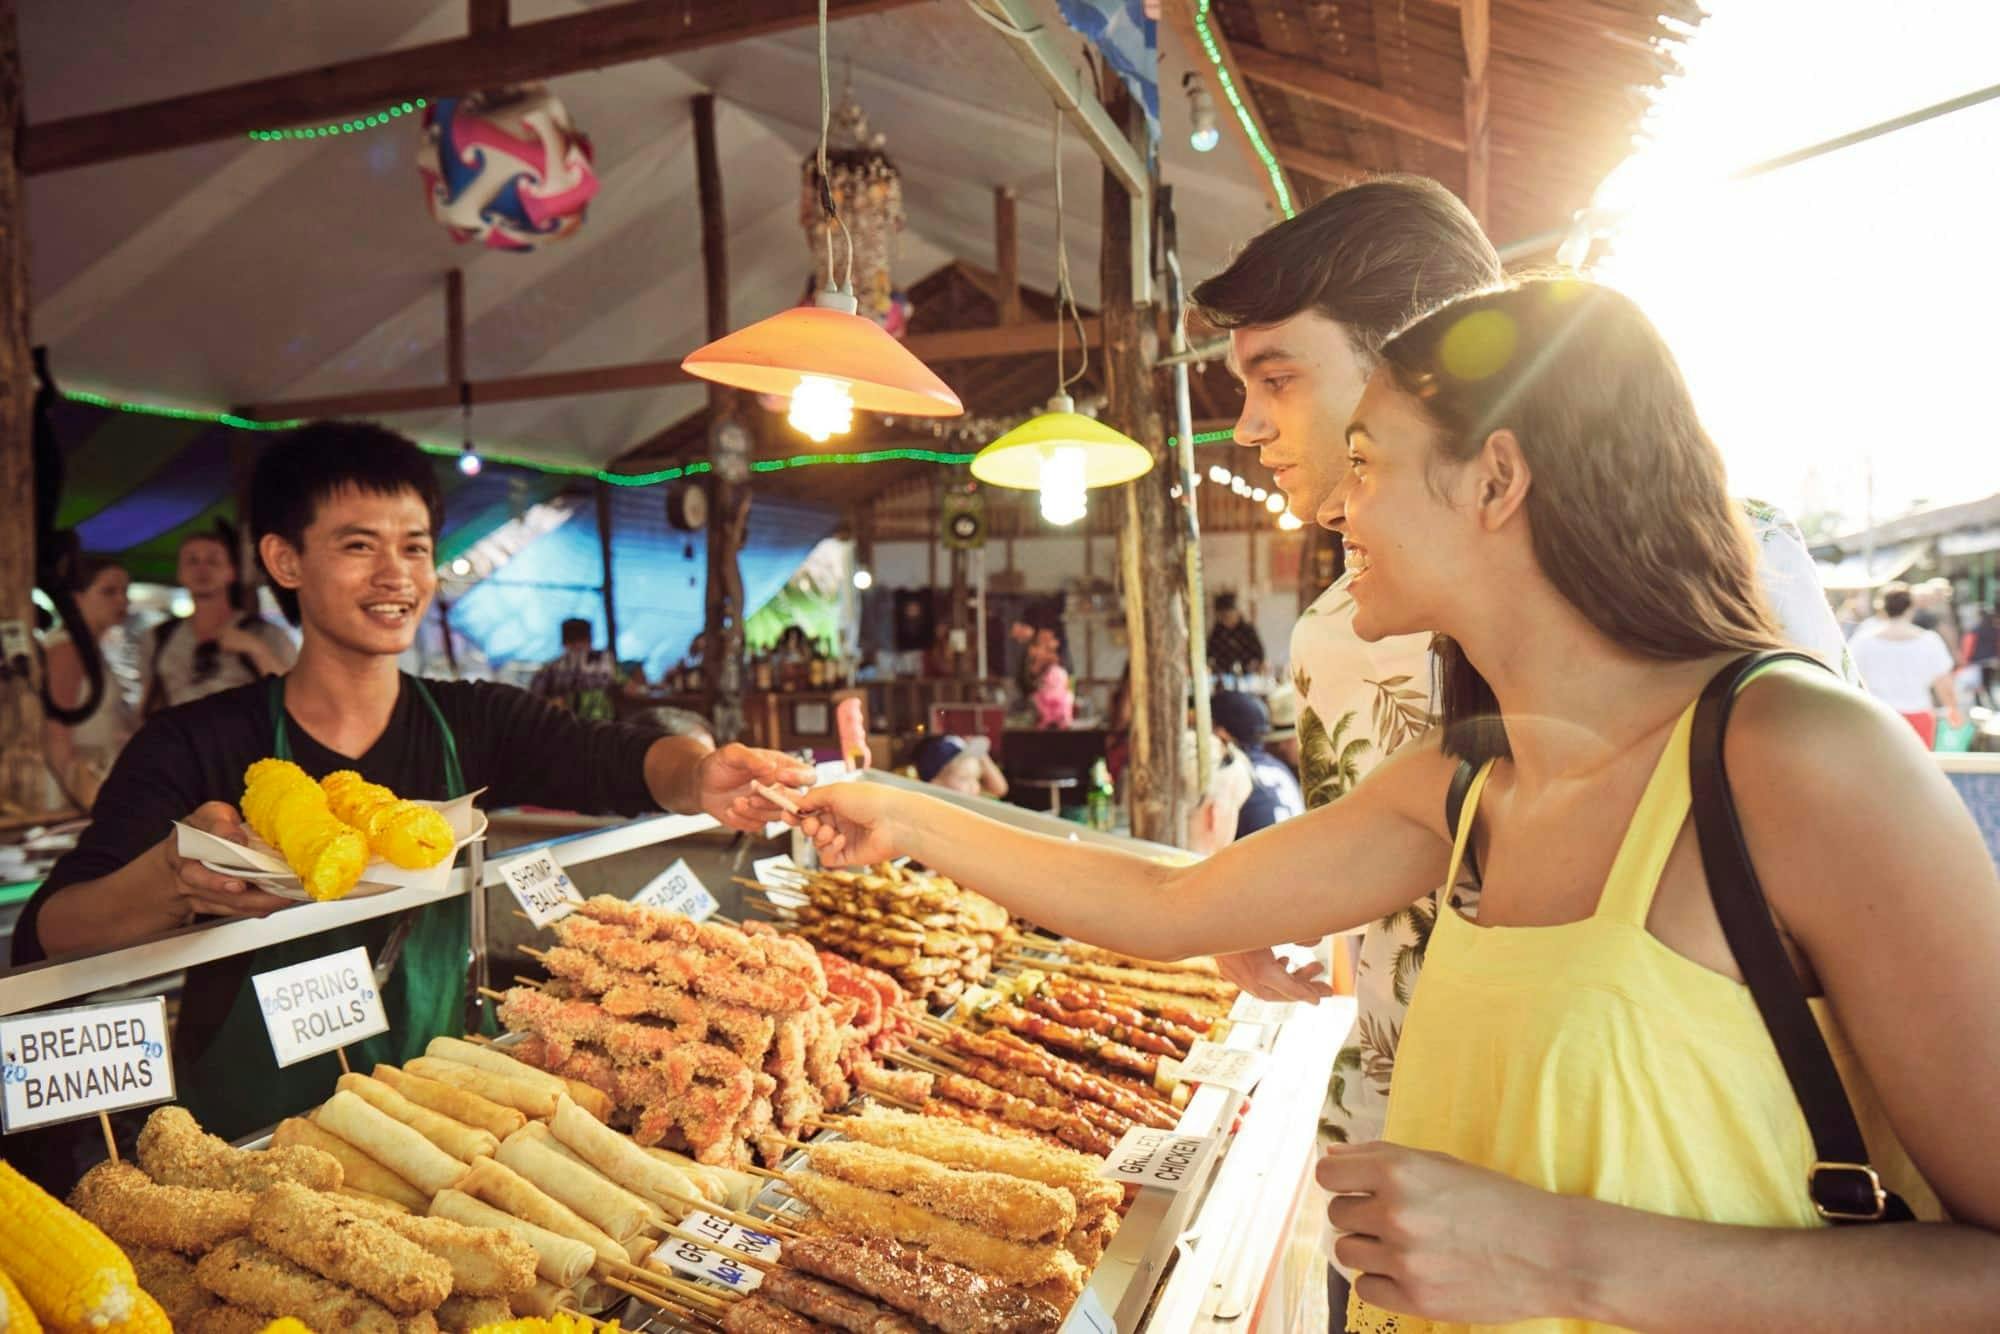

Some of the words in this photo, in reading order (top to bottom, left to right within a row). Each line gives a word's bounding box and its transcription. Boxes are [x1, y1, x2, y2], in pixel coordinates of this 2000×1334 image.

[512, 858, 552, 891] SHRIMP
[529, 881, 569, 914] BALLS
[276, 967, 360, 1012] SPRING
[20, 1017, 146, 1064] BREADED
[291, 999, 366, 1044] ROLLS
[25, 1059, 153, 1109] BANANAS
[1118, 1134, 1164, 1174] GRILLED
[1155, 1138, 1201, 1181] CHICKEN
[719, 1234, 764, 1272] PRK
